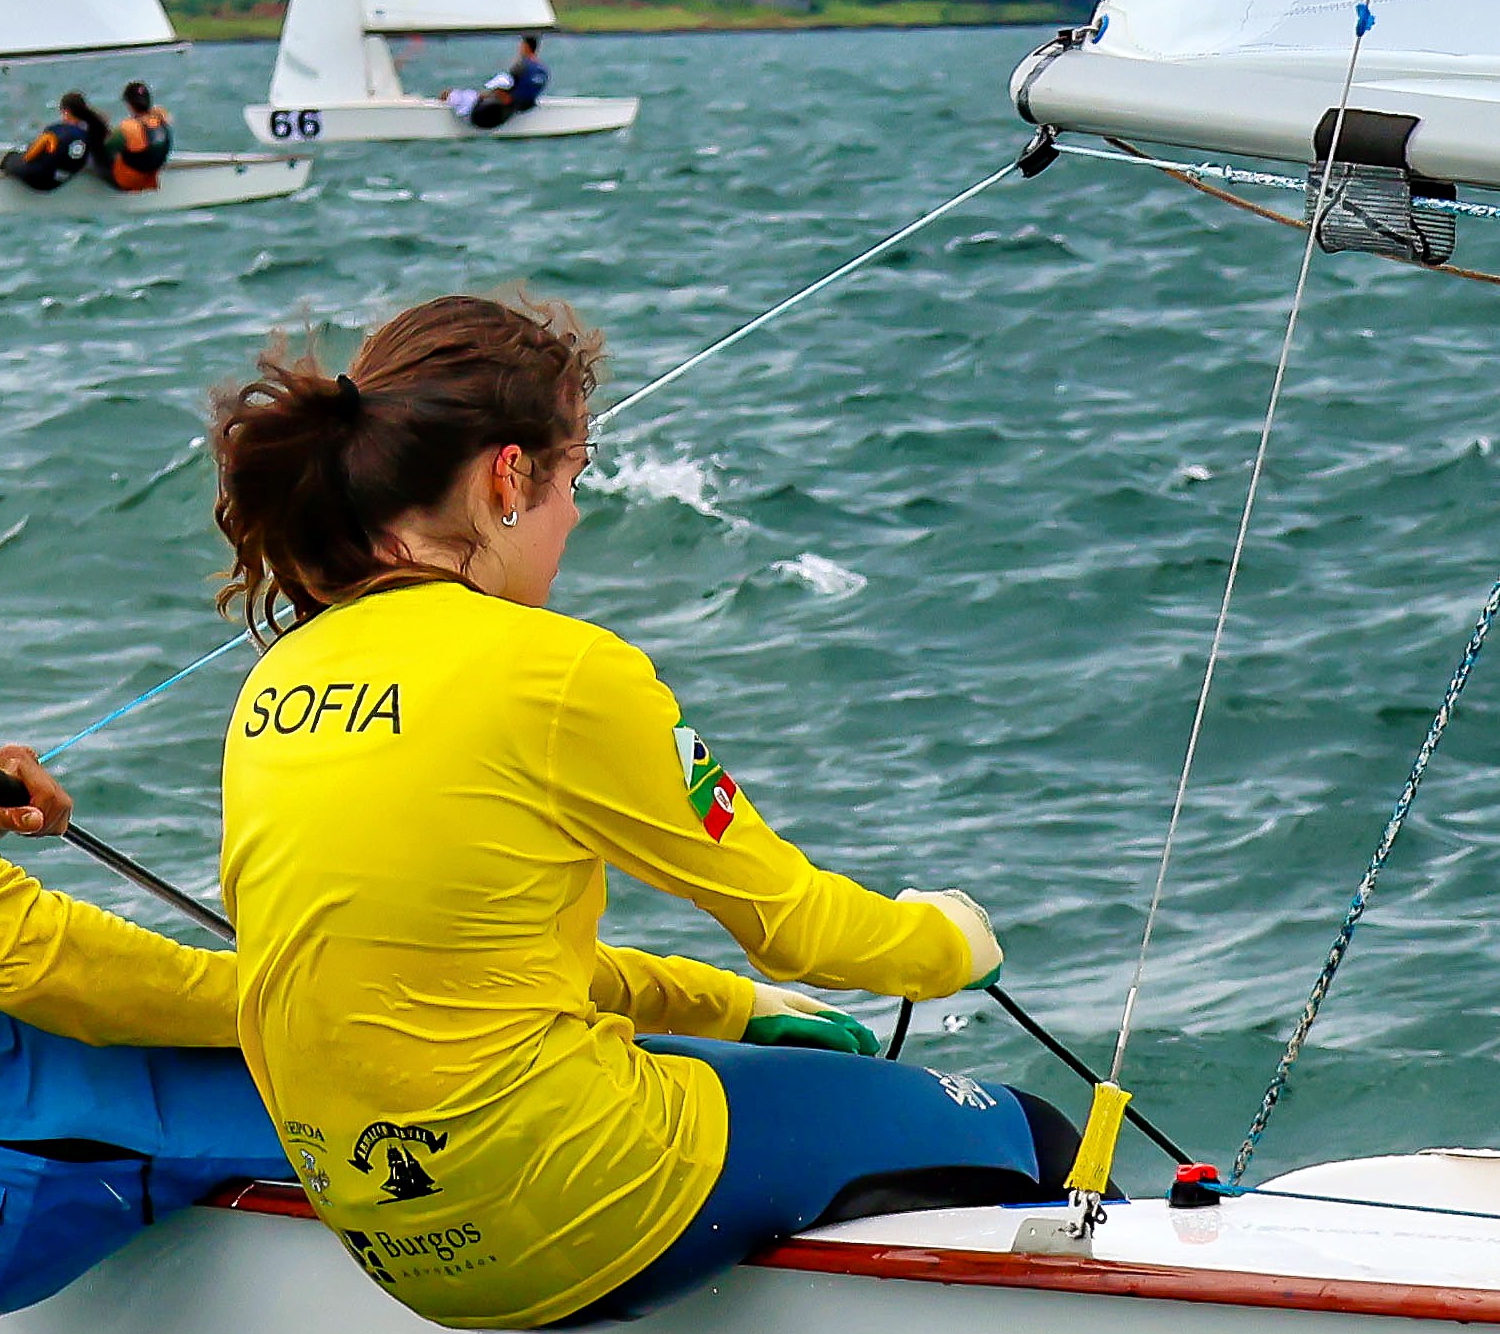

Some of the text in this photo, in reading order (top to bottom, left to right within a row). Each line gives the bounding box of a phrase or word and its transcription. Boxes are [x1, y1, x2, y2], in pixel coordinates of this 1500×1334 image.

[270, 109, 320, 138] 66
[245, 683, 401, 738] SOFIA
[374, 1222, 481, 1262] Burgos
